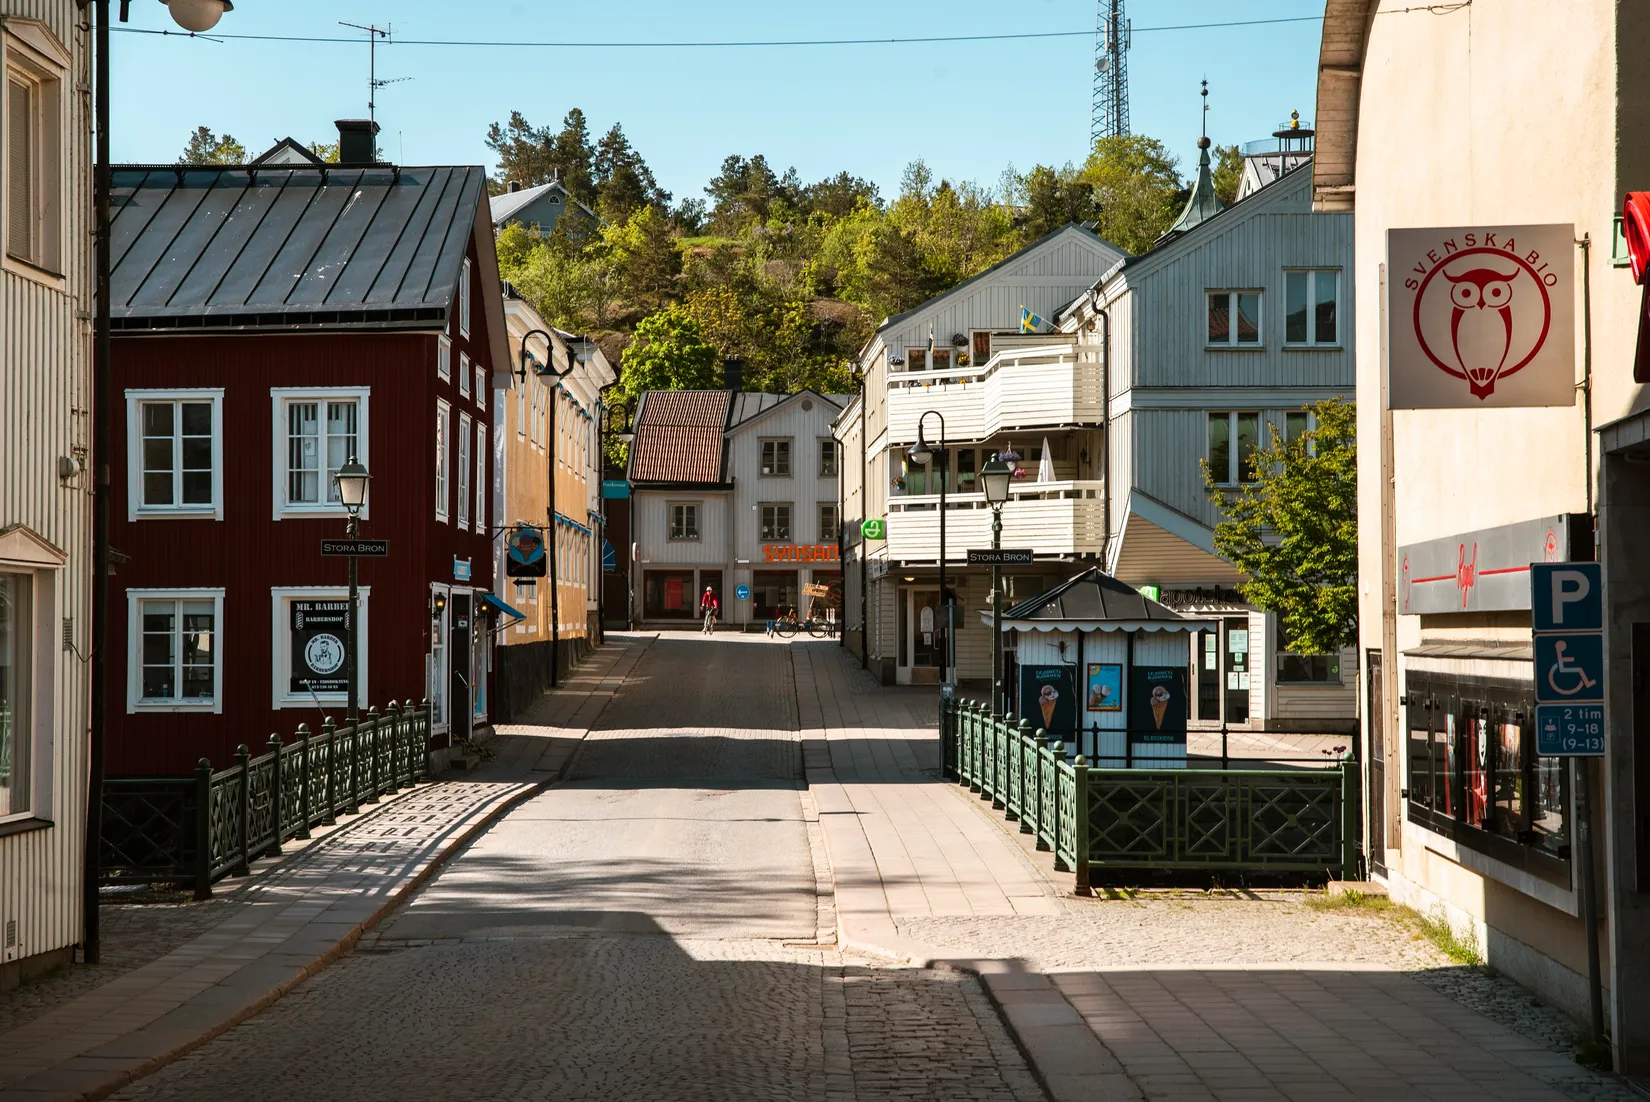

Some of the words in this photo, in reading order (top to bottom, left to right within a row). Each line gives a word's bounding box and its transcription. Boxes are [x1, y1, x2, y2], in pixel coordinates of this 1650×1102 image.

[1404, 232, 1517, 291] SVENSKA
[1524, 249, 1558, 287] BIO
[1551, 570, 1590, 624] P
[296, 602, 313, 611] MR.
[1564, 708, 1572, 720] 2
[1579, 708, 1601, 720] tim
[1567, 723, 1599, 735] 9-18
[1562, 737, 1604, 750] (9-13)
